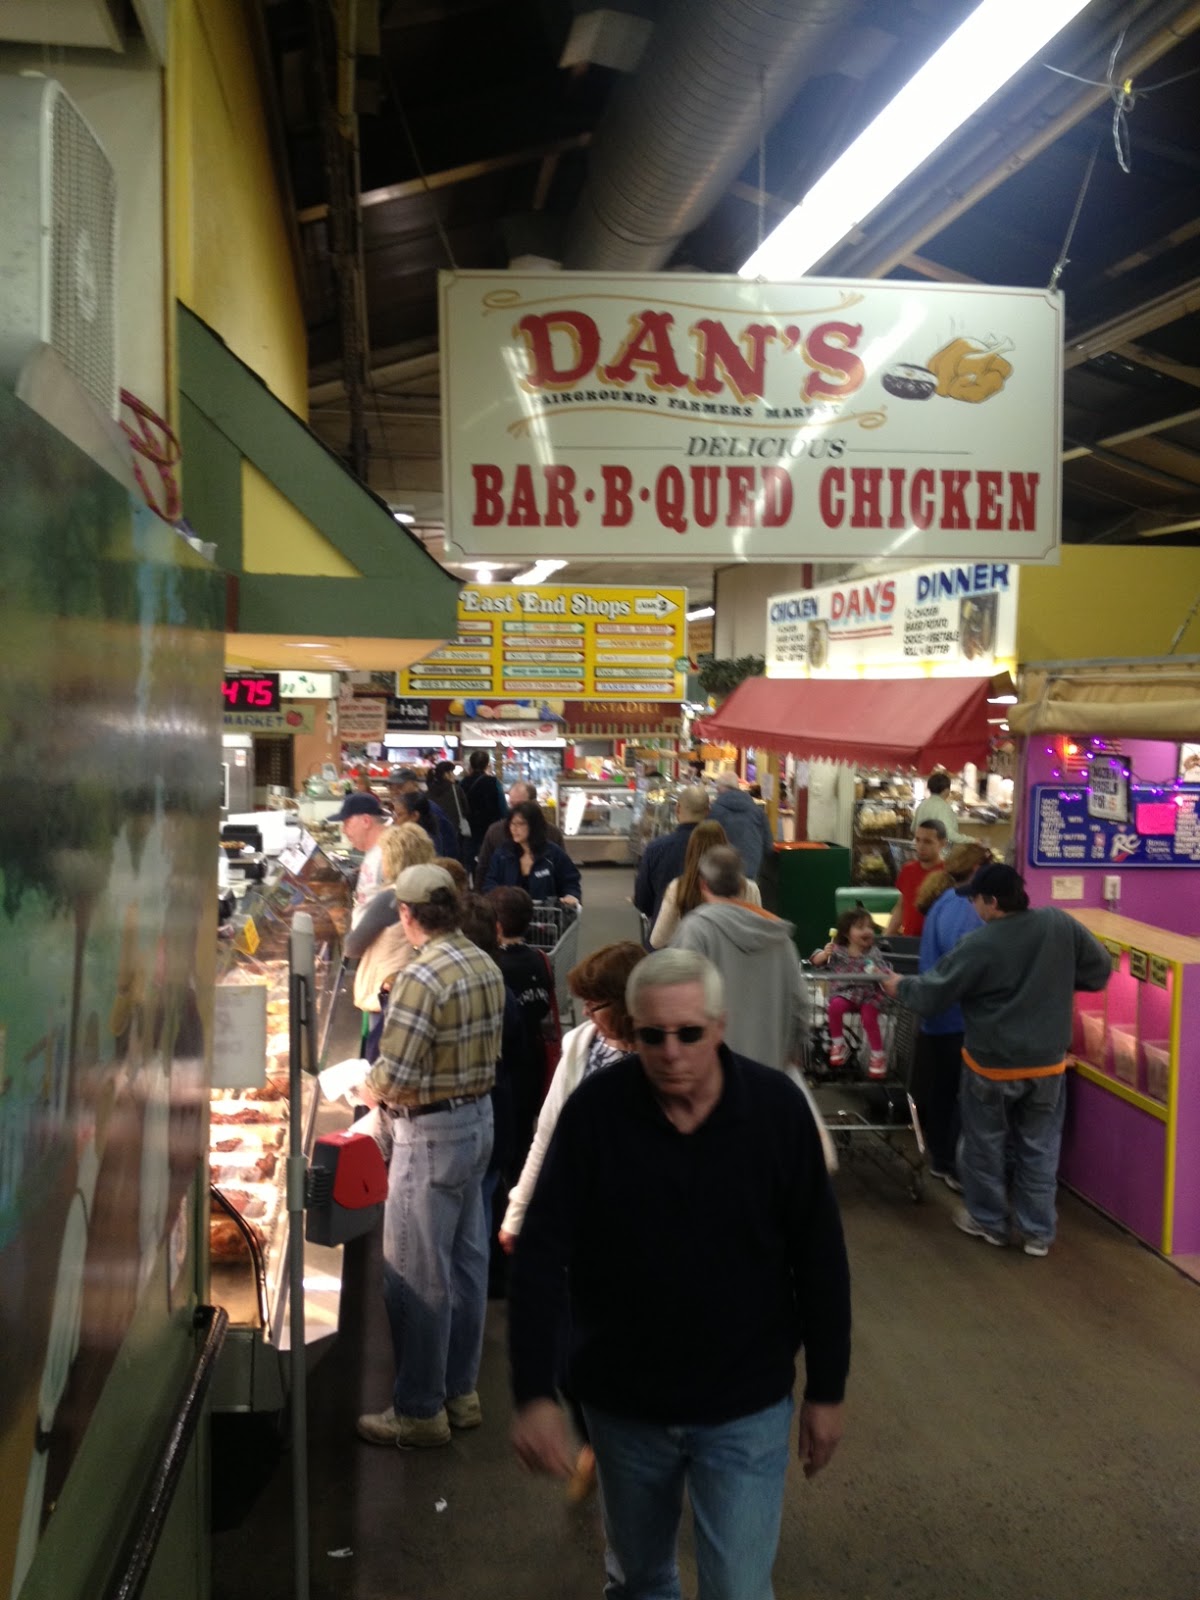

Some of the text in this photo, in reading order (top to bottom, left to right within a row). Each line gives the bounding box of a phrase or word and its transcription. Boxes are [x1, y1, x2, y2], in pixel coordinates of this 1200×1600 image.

[514, 309, 866, 404] DAN'S
[532, 390, 657, 406] AIRGROUNDS
[668, 398, 754, 417] FARMERS
[684, 436, 848, 460] DELICIOUS
[818, 466, 1040, 532] CHICKEN
[917, 563, 1010, 603] DINNER
[458, 591, 515, 613] East
[518, 591, 566, 615] End
[571, 593, 631, 620] Shops
[770, 597, 818, 622] CHICKEN
[831, 580, 896, 621] DAN'S
[221, 680, 273, 705] 475
[223, 714, 284, 727] MARKET
